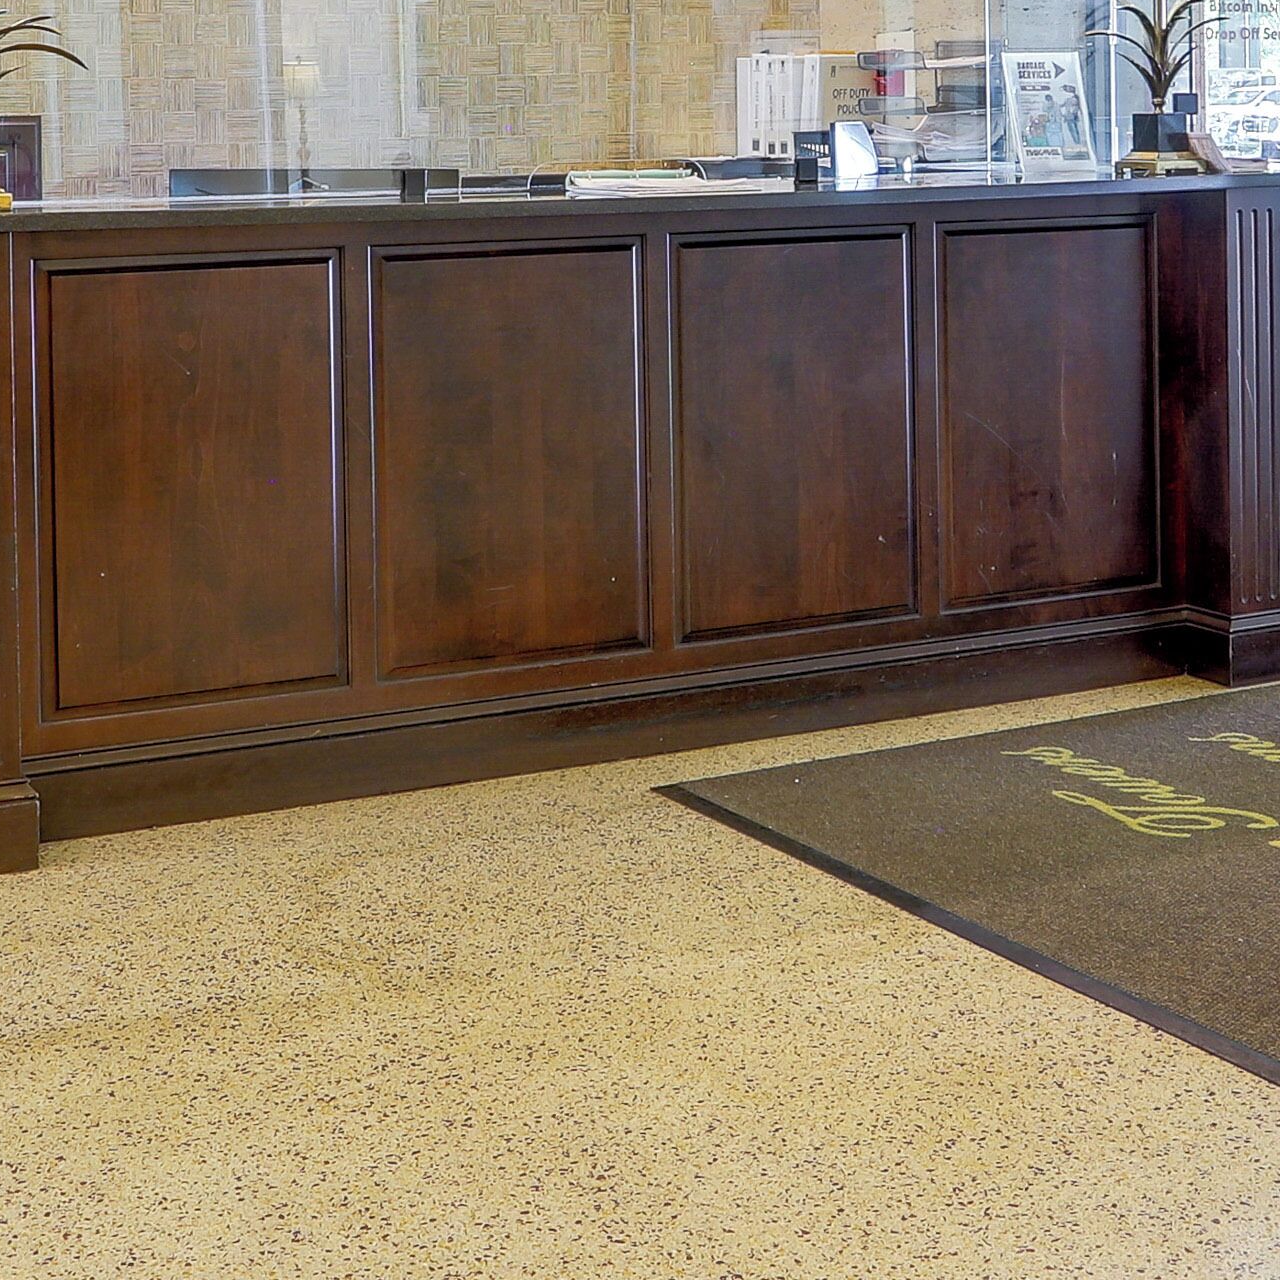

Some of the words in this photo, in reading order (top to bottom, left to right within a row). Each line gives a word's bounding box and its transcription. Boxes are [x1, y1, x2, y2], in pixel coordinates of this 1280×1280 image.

[1240, 27, 1260, 40] Off
[832, 88, 848, 99] OFF
[849, 88, 871, 99] DUTY
[1001, 746, 1280, 838] Towers
